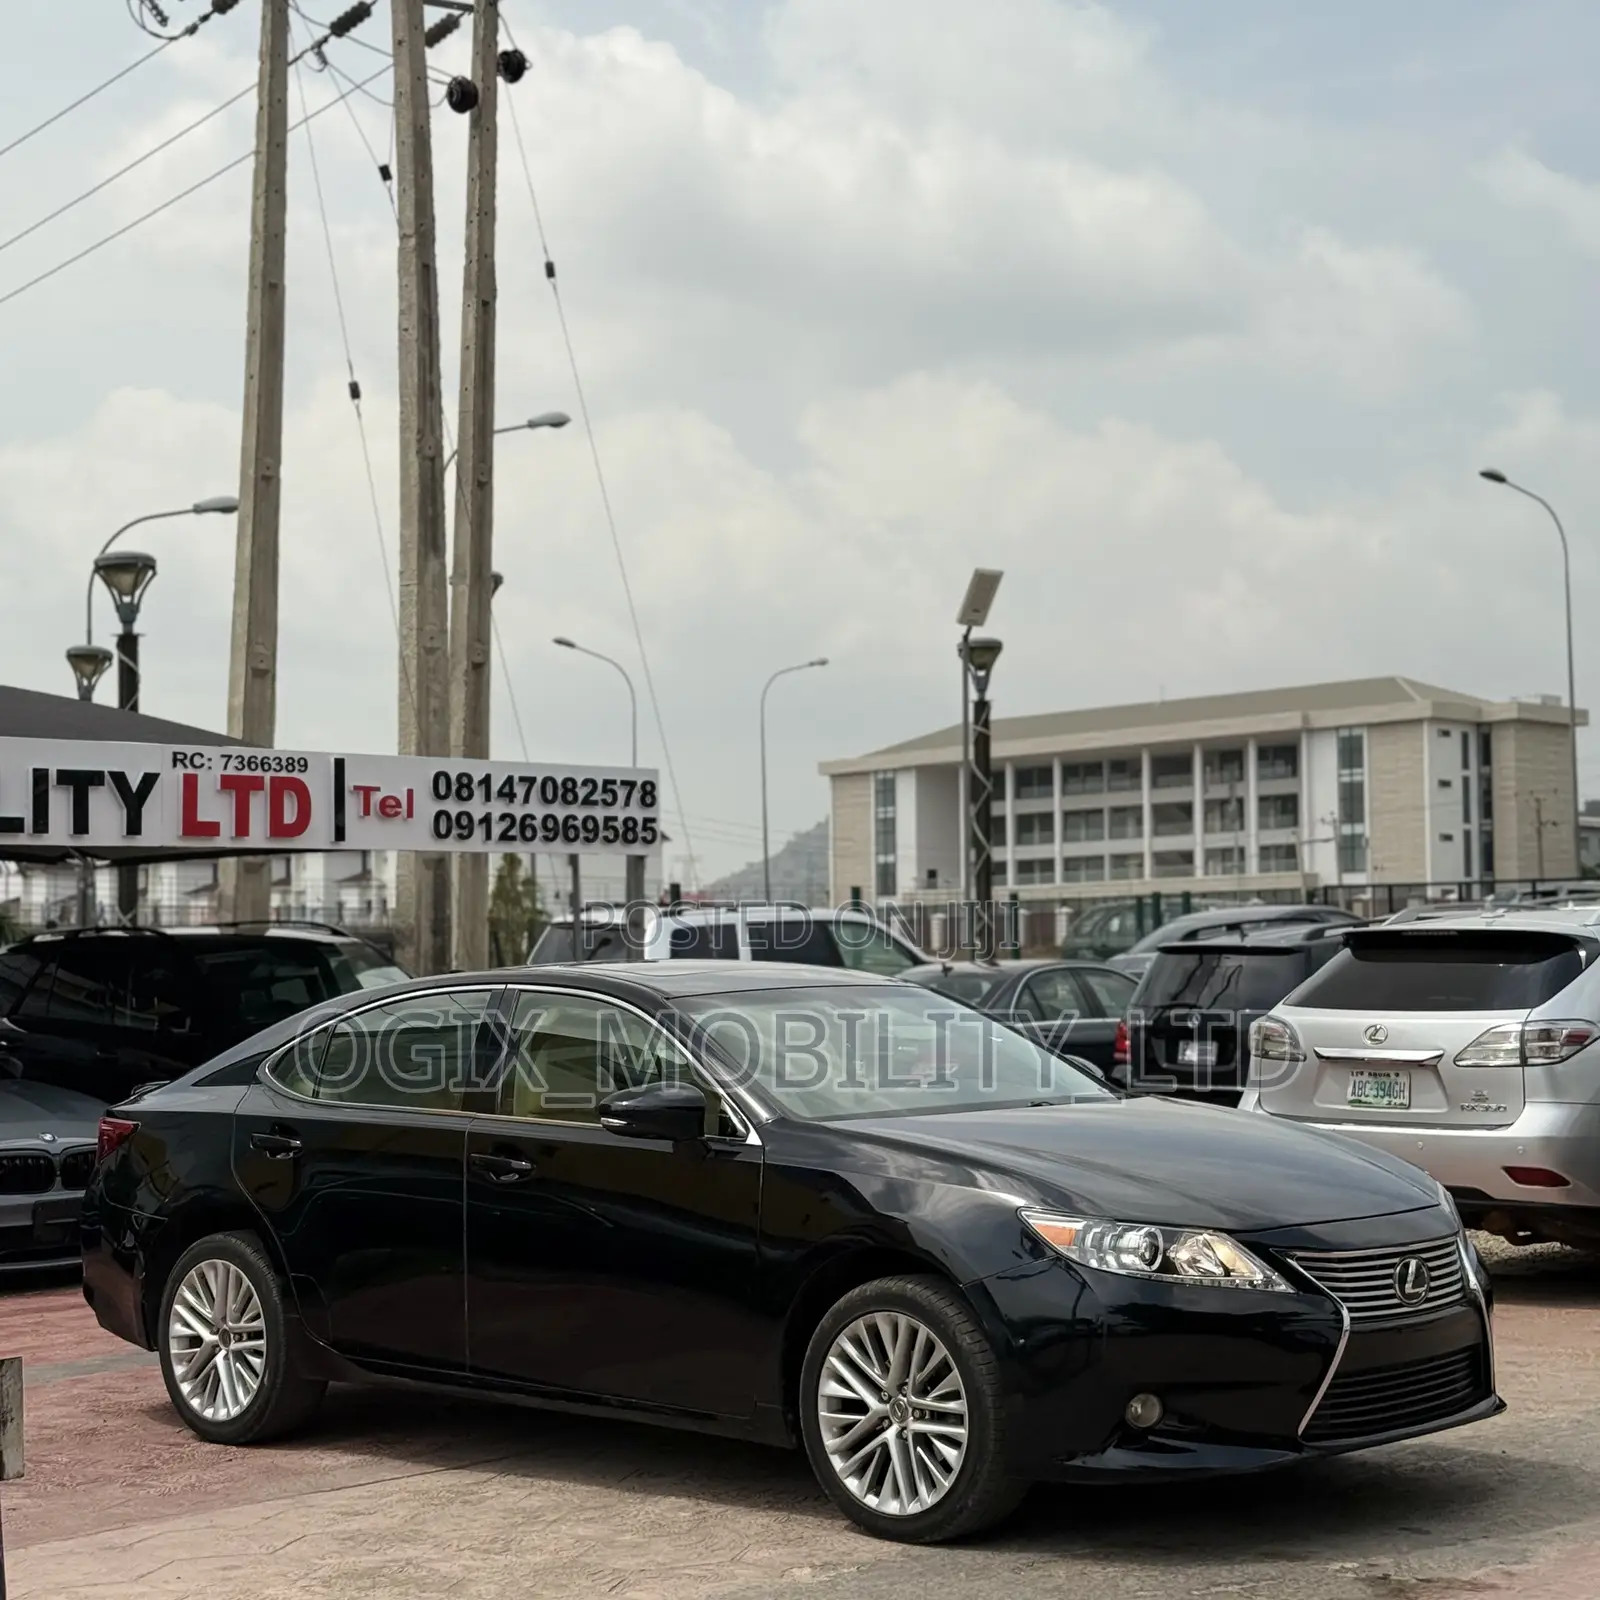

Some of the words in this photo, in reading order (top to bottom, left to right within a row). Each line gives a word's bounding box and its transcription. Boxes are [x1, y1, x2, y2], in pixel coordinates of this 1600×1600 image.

[172, 751, 213, 770] RC:
[220, 754, 309, 774] 7366389
[0, 768, 161, 836] ITY
[181, 772, 312, 838] LTD
[352, 785, 414, 819] Tel
[432, 770, 657, 808] 08147082578
[432, 809, 658, 845] 09126969585
